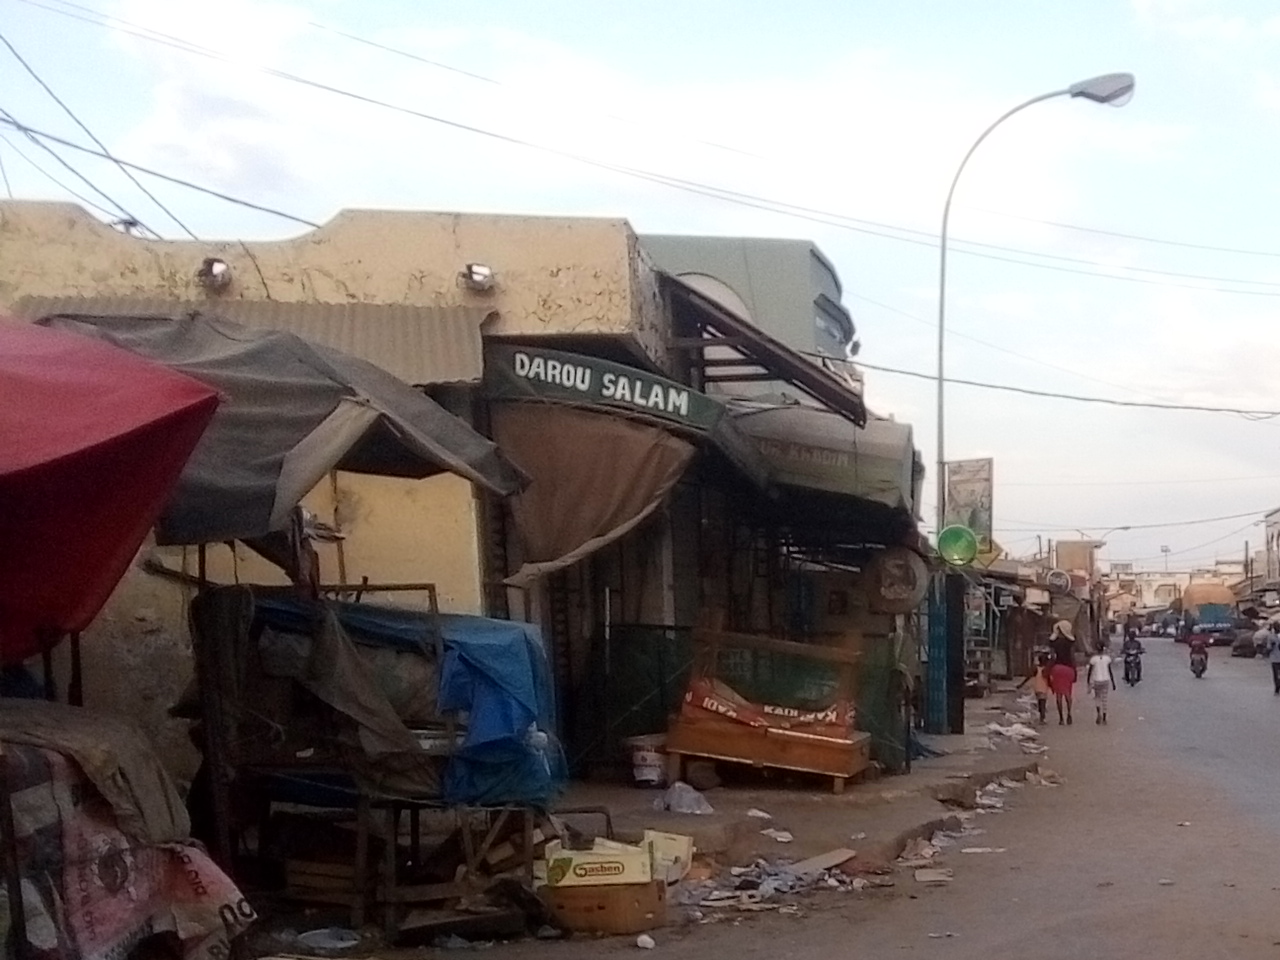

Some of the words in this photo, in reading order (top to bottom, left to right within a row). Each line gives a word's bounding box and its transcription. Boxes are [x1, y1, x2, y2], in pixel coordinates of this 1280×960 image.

[515, 352, 592, 392] DAROU
[601, 373, 690, 416] SALAM
[763, 704, 799, 718] KADI
